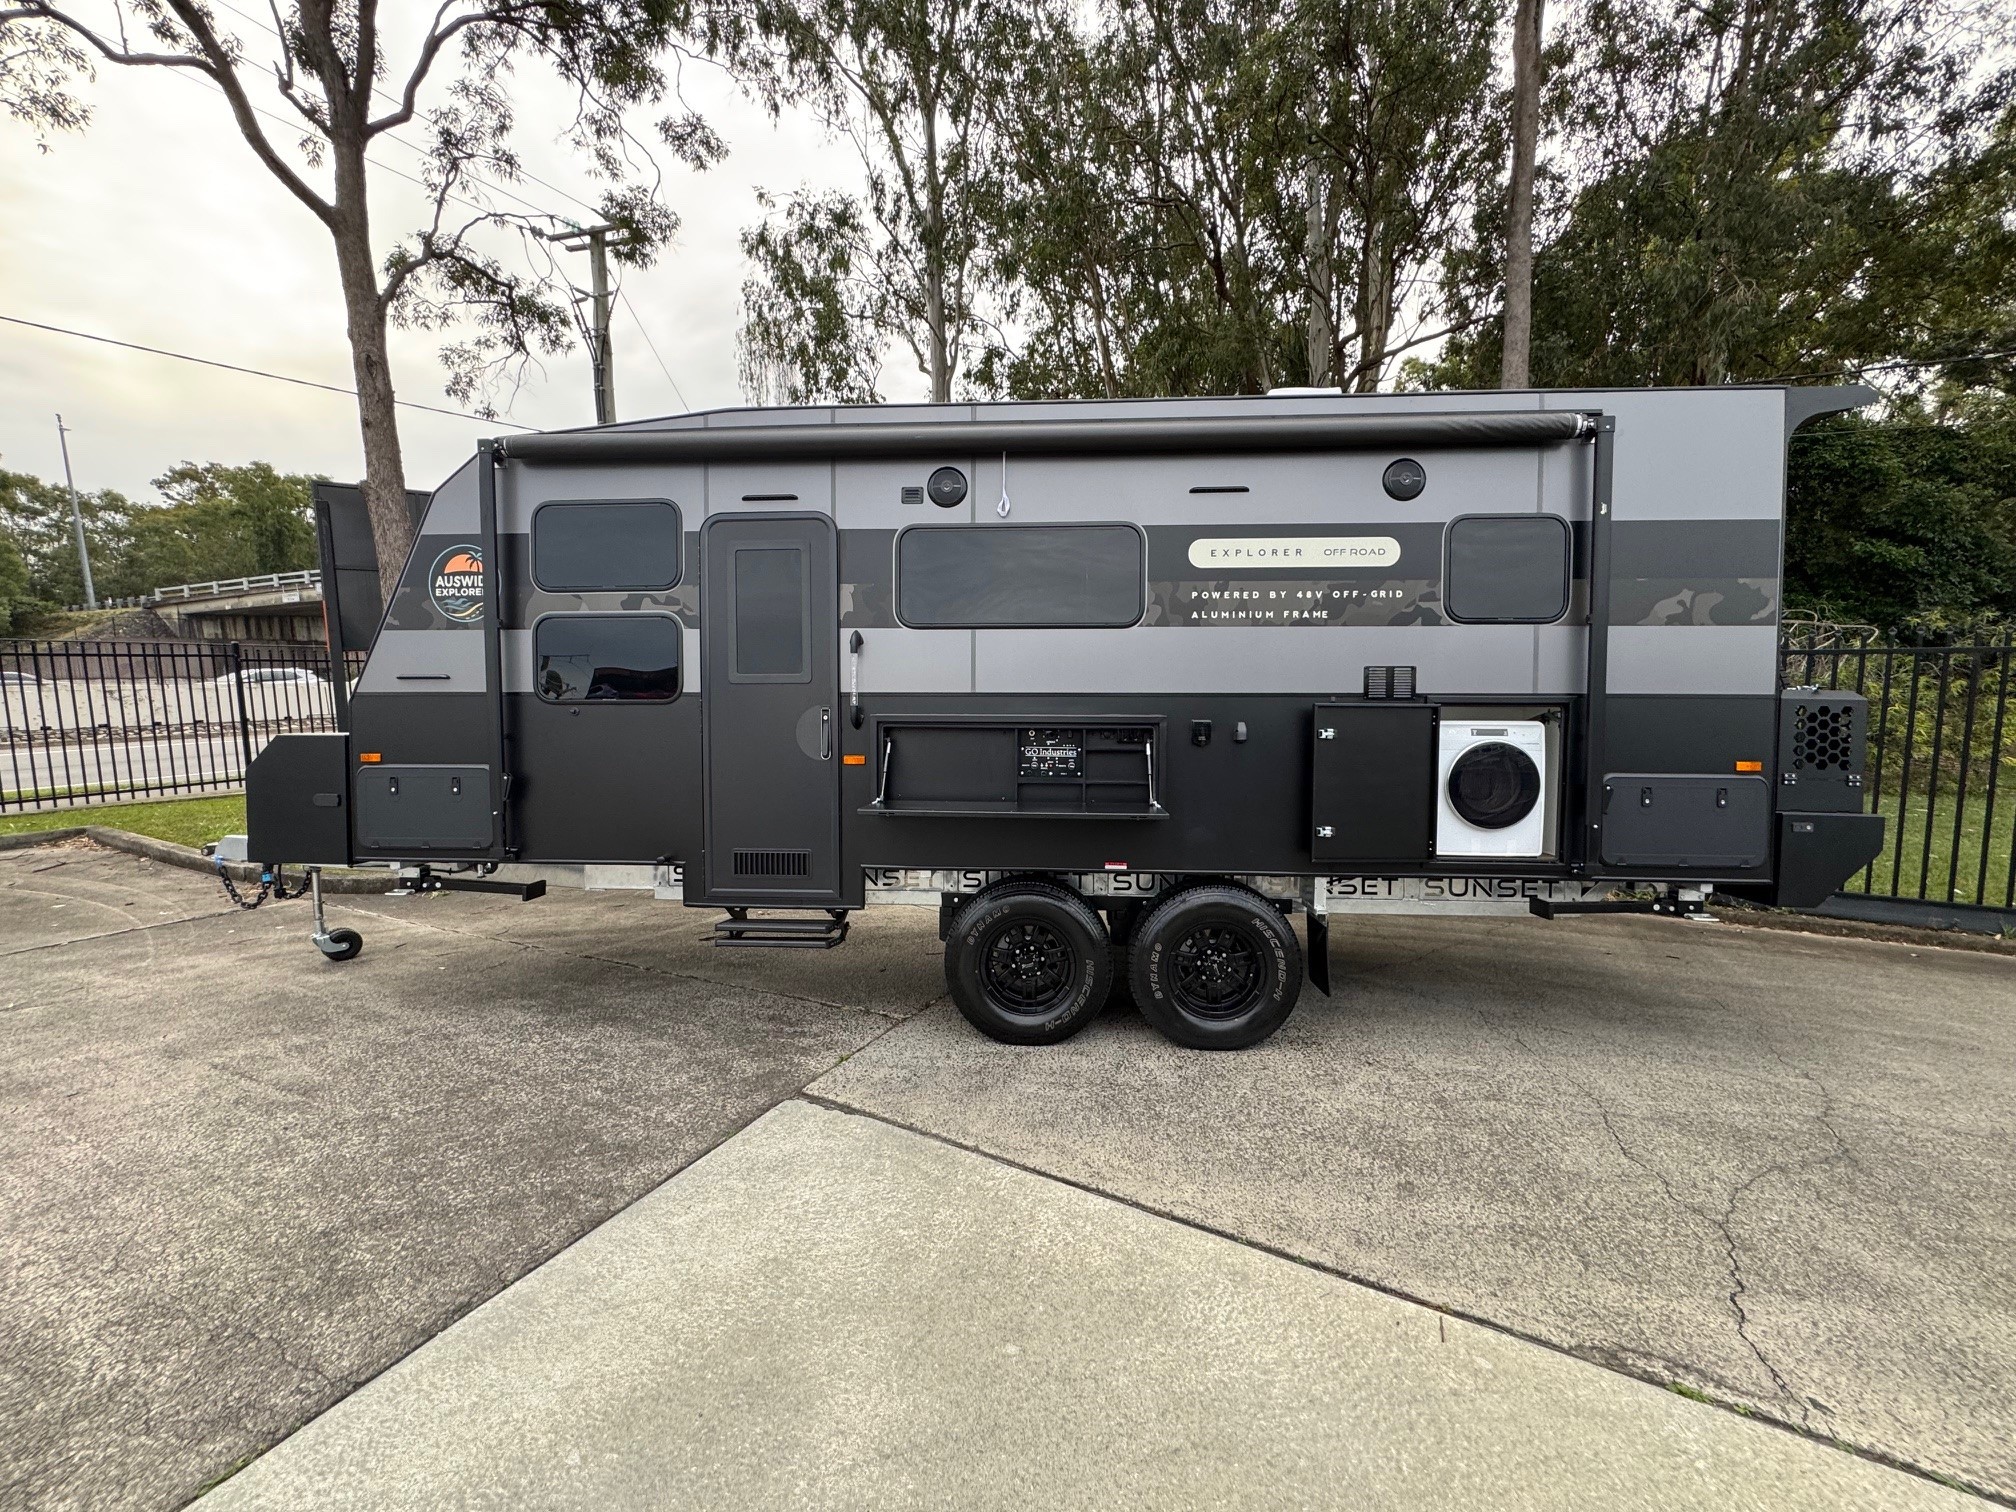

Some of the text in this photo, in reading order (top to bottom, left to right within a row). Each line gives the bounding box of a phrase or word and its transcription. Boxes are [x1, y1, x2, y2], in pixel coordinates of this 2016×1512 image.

[1210, 548, 1386, 558] EXPLORER OFF ROAD
[435, 574, 484, 588] AUSWID
[435, 588, 484, 597] EXPLORE
[1191, 590, 1403, 599] POWERED BY 48V OFF-GRID
[1191, 610, 1329, 619] ALUMINIUM FRAME
[1025, 748, 1077, 756] GO Industries
[1424, 877, 1560, 898] SUNSET
[967, 905, 1011, 945] DYNAMO
[1149, 942, 1164, 1000] DYNAMO
